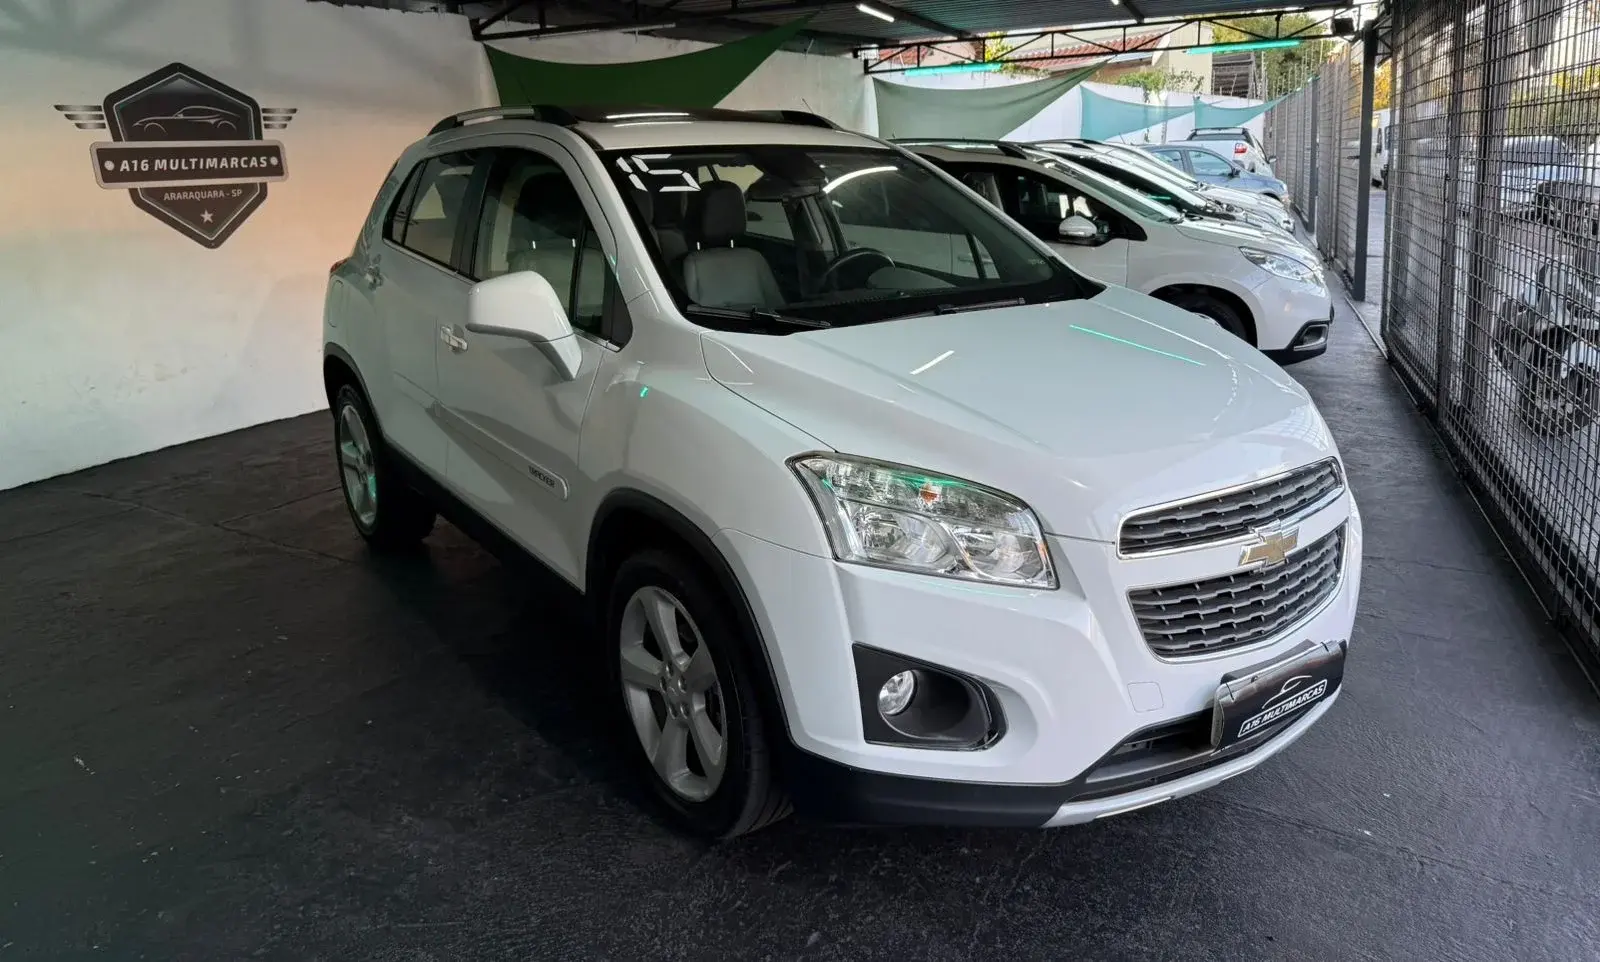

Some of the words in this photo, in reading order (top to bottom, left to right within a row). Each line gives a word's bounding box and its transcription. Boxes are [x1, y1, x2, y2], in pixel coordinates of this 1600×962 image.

[119, 159, 149, 172] A16
[154, 156, 268, 171] MULTIMARCAS
[616, 153, 702, 192] 15
[163, 190, 225, 201] ARARAQUARA
[231, 189, 243, 198] SP
[1243, 717, 1262, 732] A16
[1261, 684, 1324, 723] MULTIMARCAS
